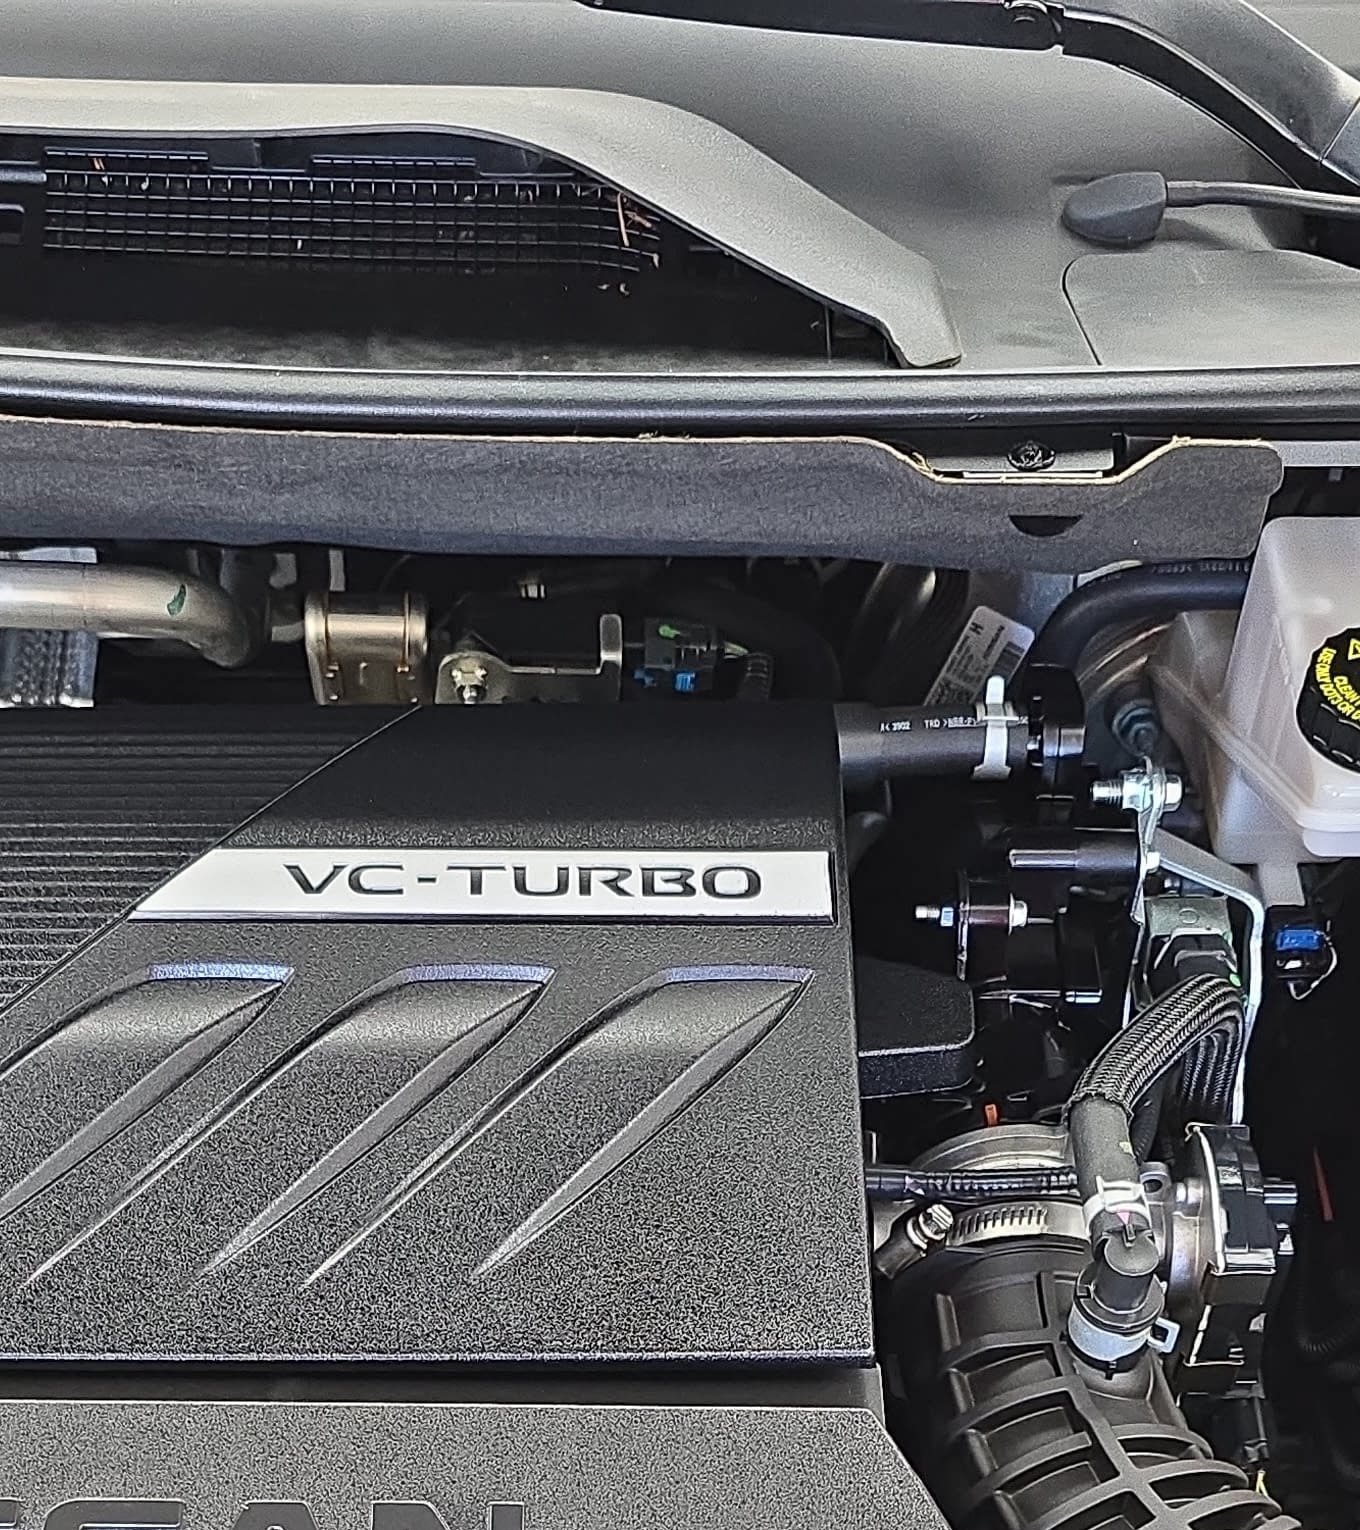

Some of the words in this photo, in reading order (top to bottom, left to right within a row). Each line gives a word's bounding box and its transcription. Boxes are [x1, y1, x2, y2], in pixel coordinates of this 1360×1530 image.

[1315, 663, 1331, 684] ONLY
[1320, 681, 1340, 706] DOT3
[1334, 676, 1359, 703] CLEAN
[1337, 701, 1355, 716] OR
[283, 864, 762, 899] VC-TURBO
